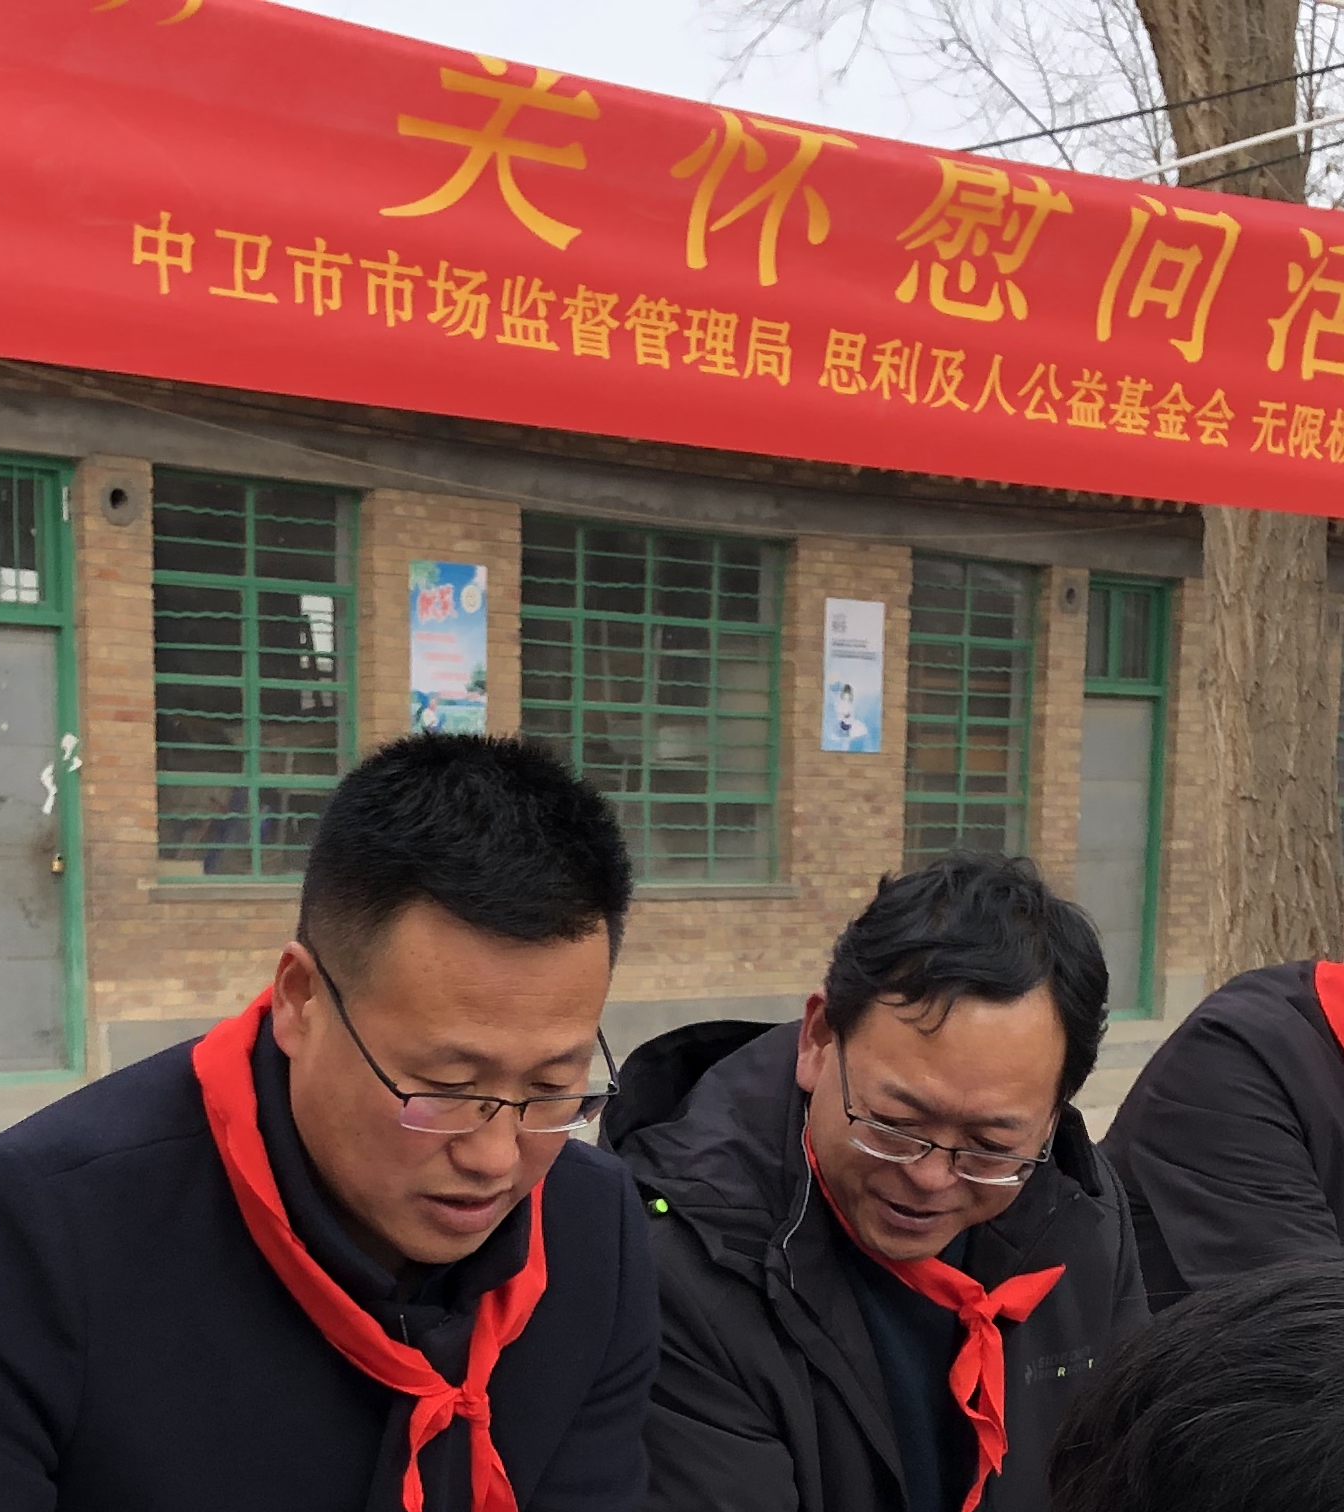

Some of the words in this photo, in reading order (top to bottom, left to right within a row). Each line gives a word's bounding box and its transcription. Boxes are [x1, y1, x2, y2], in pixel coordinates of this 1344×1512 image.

[131, 211, 793, 388] 中卫市市场监督管理局
[818, 328, 1235, 449] 思利及人公益基金会
